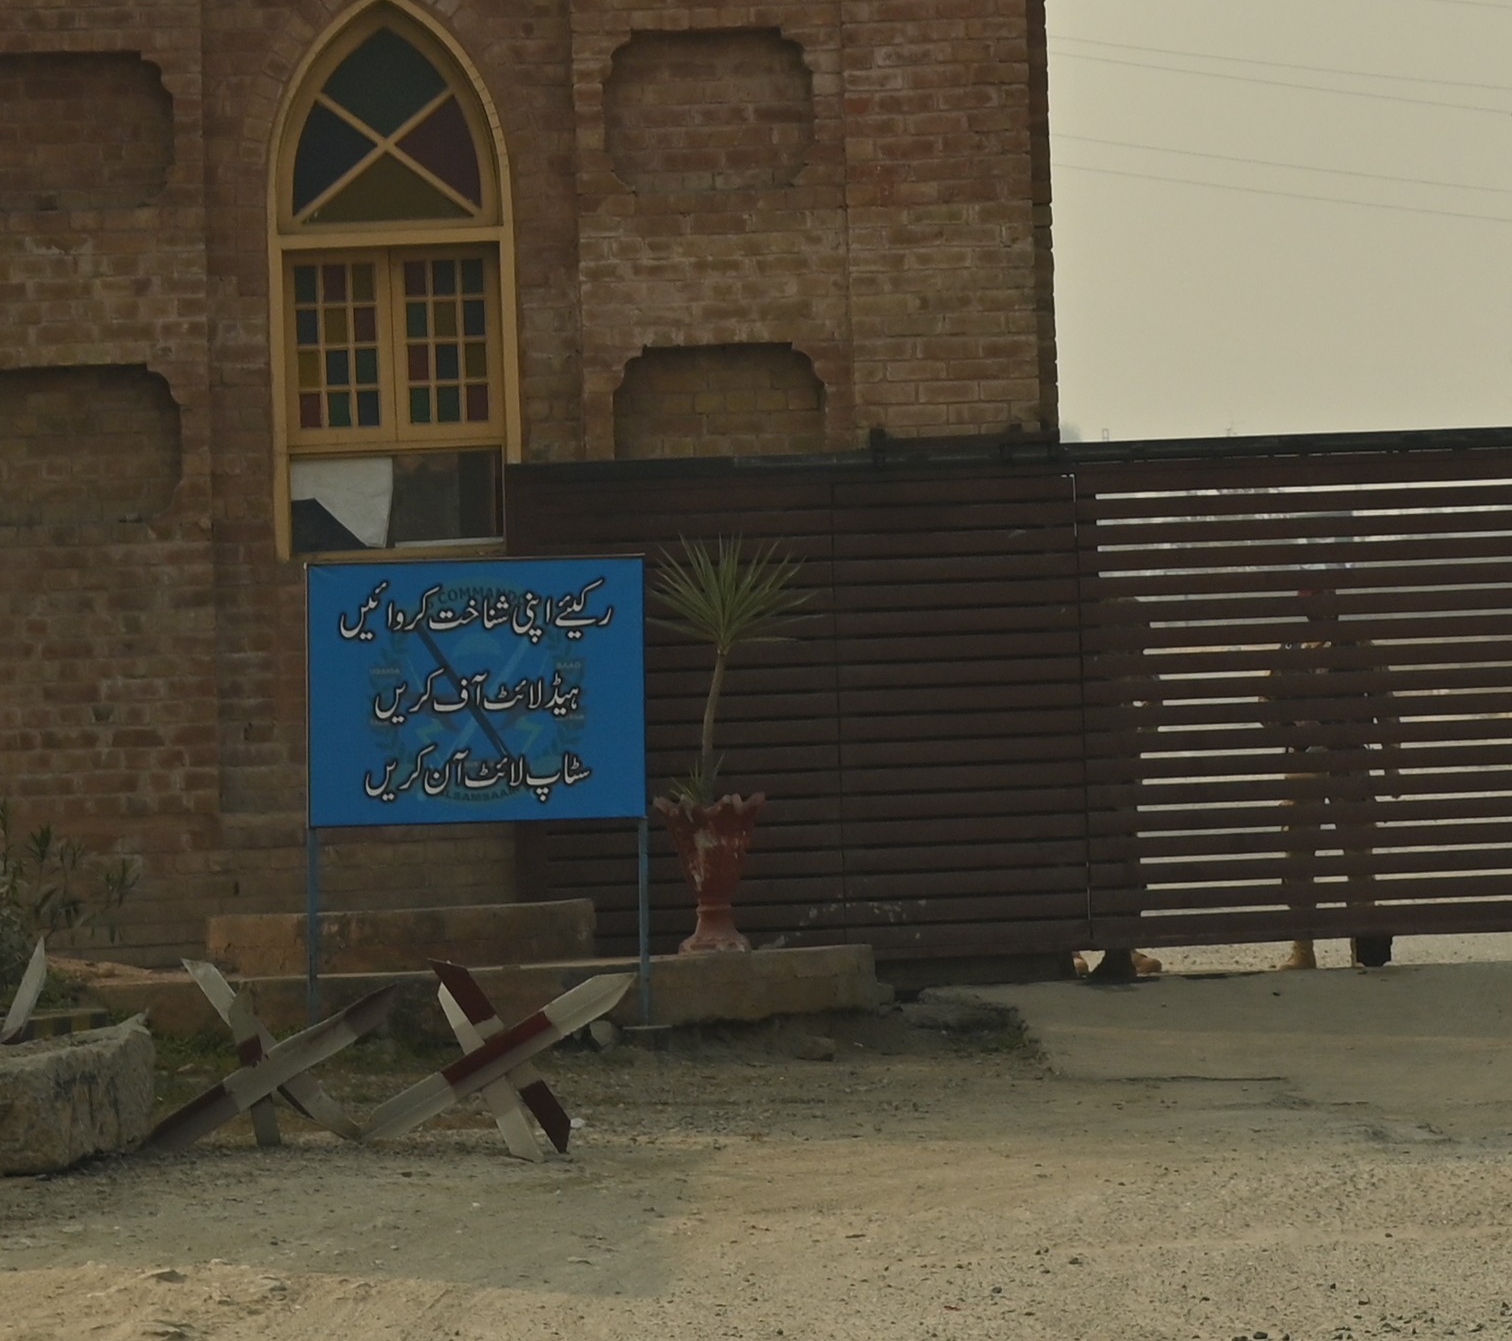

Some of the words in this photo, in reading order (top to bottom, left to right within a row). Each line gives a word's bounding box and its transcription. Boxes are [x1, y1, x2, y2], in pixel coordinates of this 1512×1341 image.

[339, 581, 440, 641] کروائیں
[428, 593, 510, 631] شناخت
[512, 591, 552, 644] اپنی
[374, 667, 445, 725] کریں
[432, 672, 488, 713] آف
[482, 678, 543, 711] لائٹ
[543, 672, 580, 716] ہیڈ
[364, 744, 435, 802] کریں
[423, 749, 470, 796] آن
[463, 755, 524, 789] لائٹ
[525, 753, 591, 802] سٹاپ
